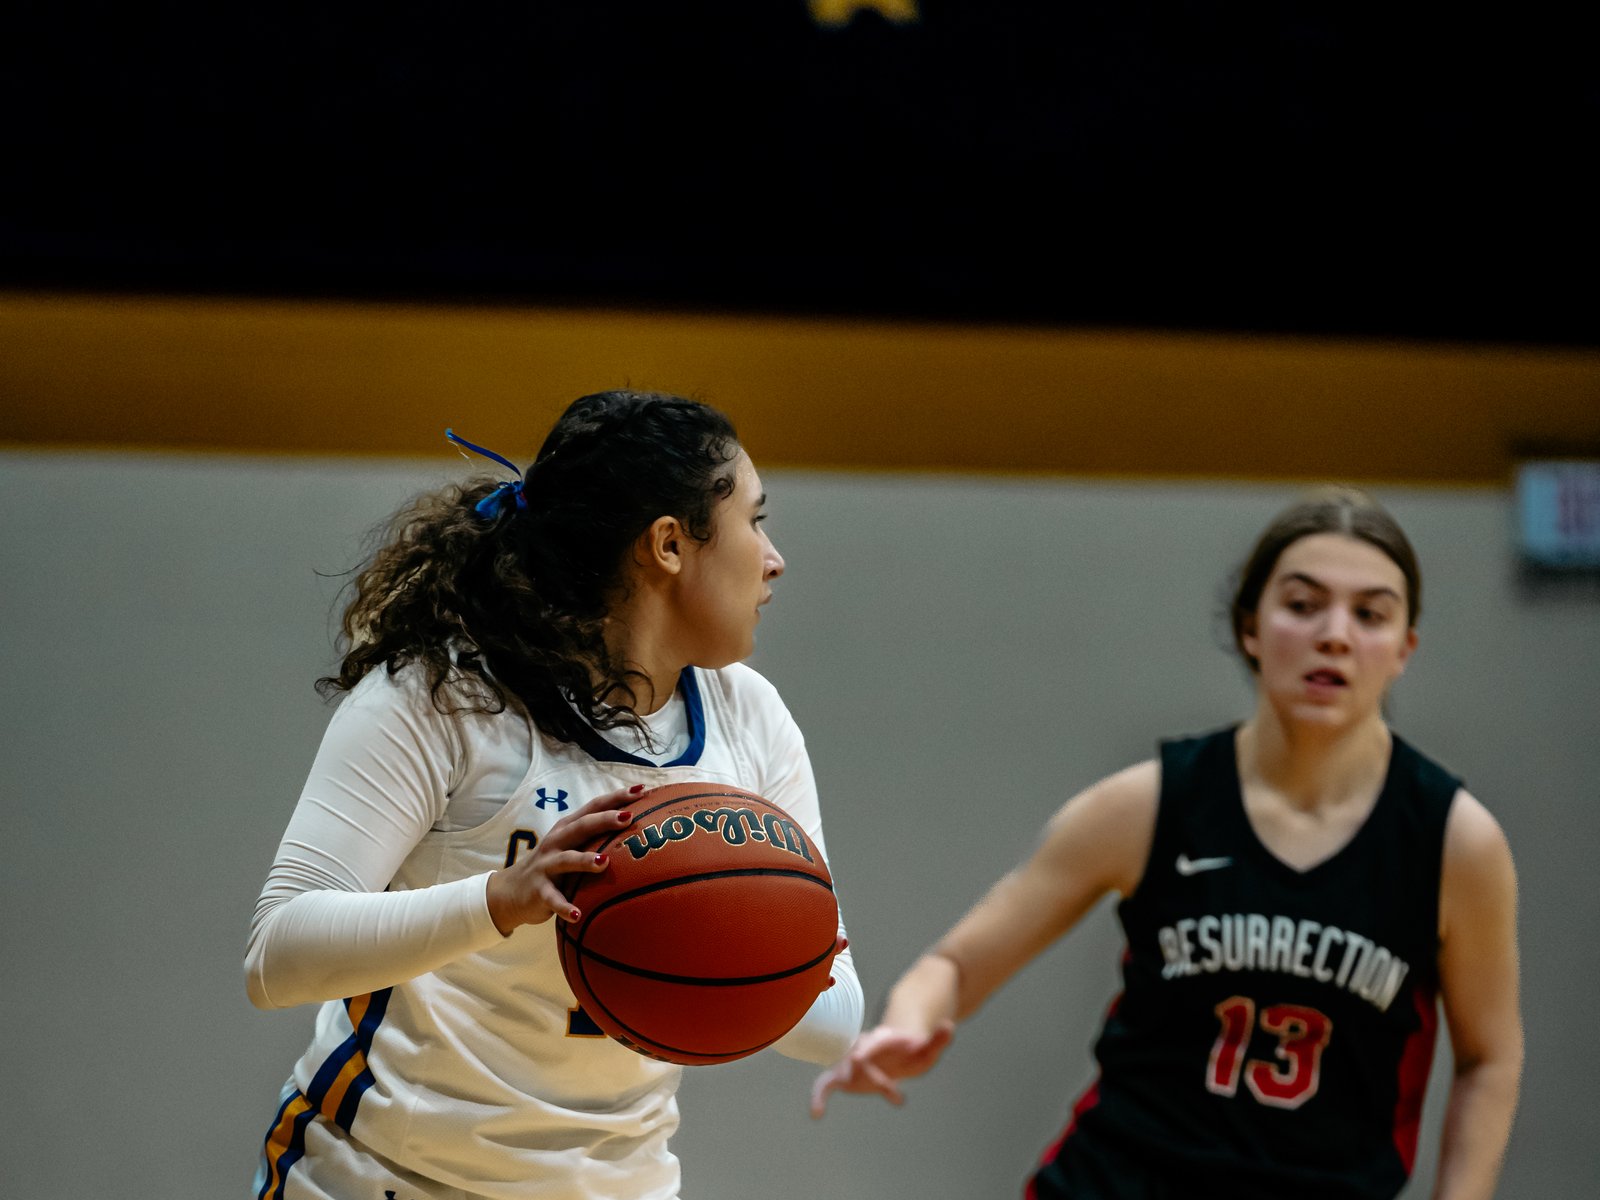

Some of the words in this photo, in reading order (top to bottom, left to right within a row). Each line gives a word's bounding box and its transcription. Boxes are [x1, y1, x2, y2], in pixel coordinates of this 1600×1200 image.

[623, 807, 816, 866] Wilson
[1158, 913, 1409, 1012] RESURRECTION
[1205, 995, 1333, 1110] 13
